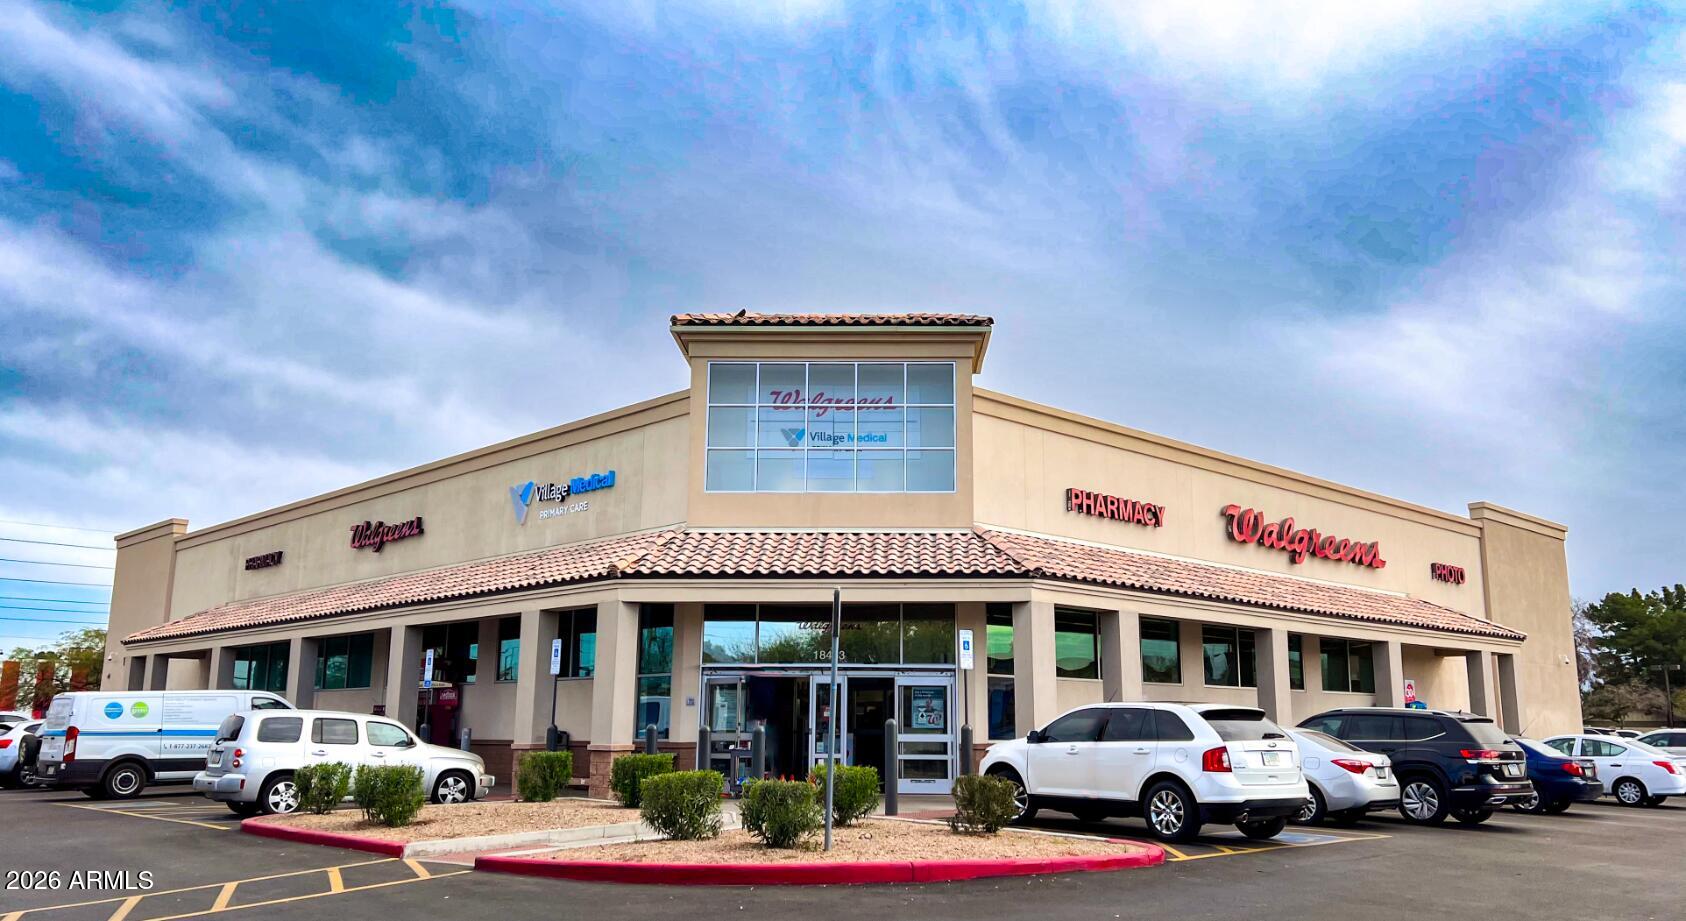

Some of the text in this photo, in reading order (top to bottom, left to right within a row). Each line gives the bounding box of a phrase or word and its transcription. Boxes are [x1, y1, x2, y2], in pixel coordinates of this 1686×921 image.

[769, 389, 896, 417] Walgreens
[809, 432, 887, 445] Village Medical
[534, 470, 616, 503] Village Medical
[539, 501, 589, 520] PRIMARY CARE
[1066, 488, 1166, 527] PHARMACY
[350, 517, 424, 553] Walgreens
[1222, 503, 1386, 568] Walgreens
[1431, 562, 1466, 585] PHOTO
[813, 650, 846, 660] 1843
